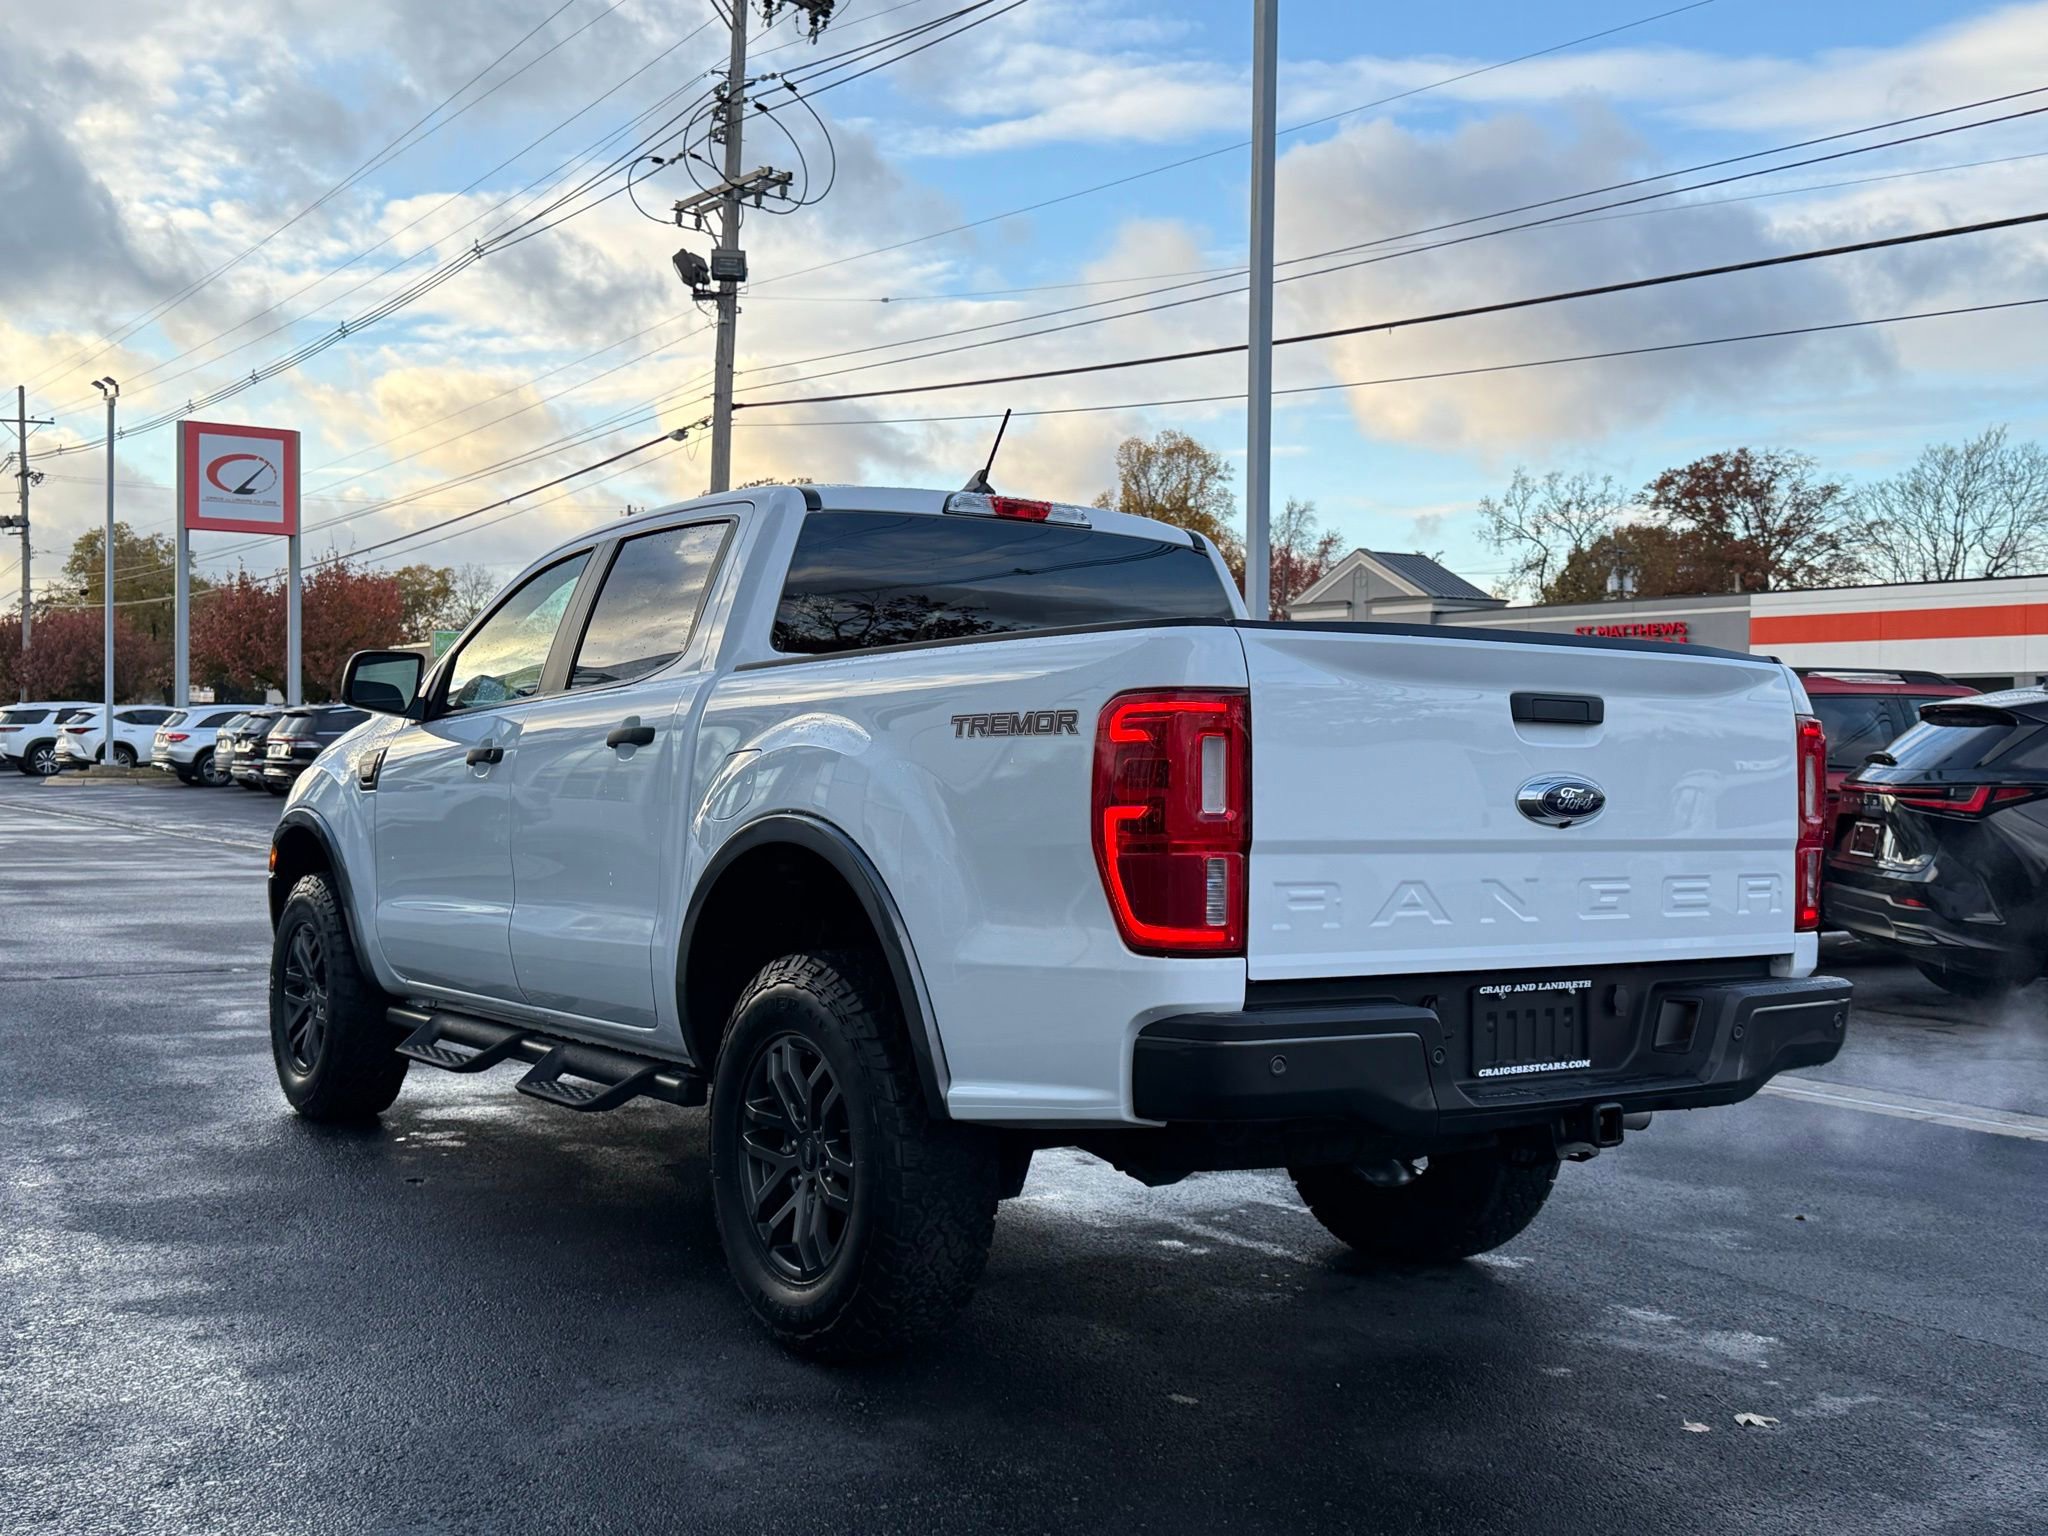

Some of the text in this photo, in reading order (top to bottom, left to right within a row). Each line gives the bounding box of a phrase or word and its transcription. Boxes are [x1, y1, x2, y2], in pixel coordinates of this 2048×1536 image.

[1597, 622, 1688, 637] MATTHEWS
[951, 709, 1080, 738] TREMOR
[1556, 787, 1594, 810] Ford
[1272, 872, 1783, 930] RANGER
[1479, 980, 1592, 994] CRAIG AND LANDRETH
[1478, 1060, 1591, 1077] CRAIGSBESTCARS.COM
